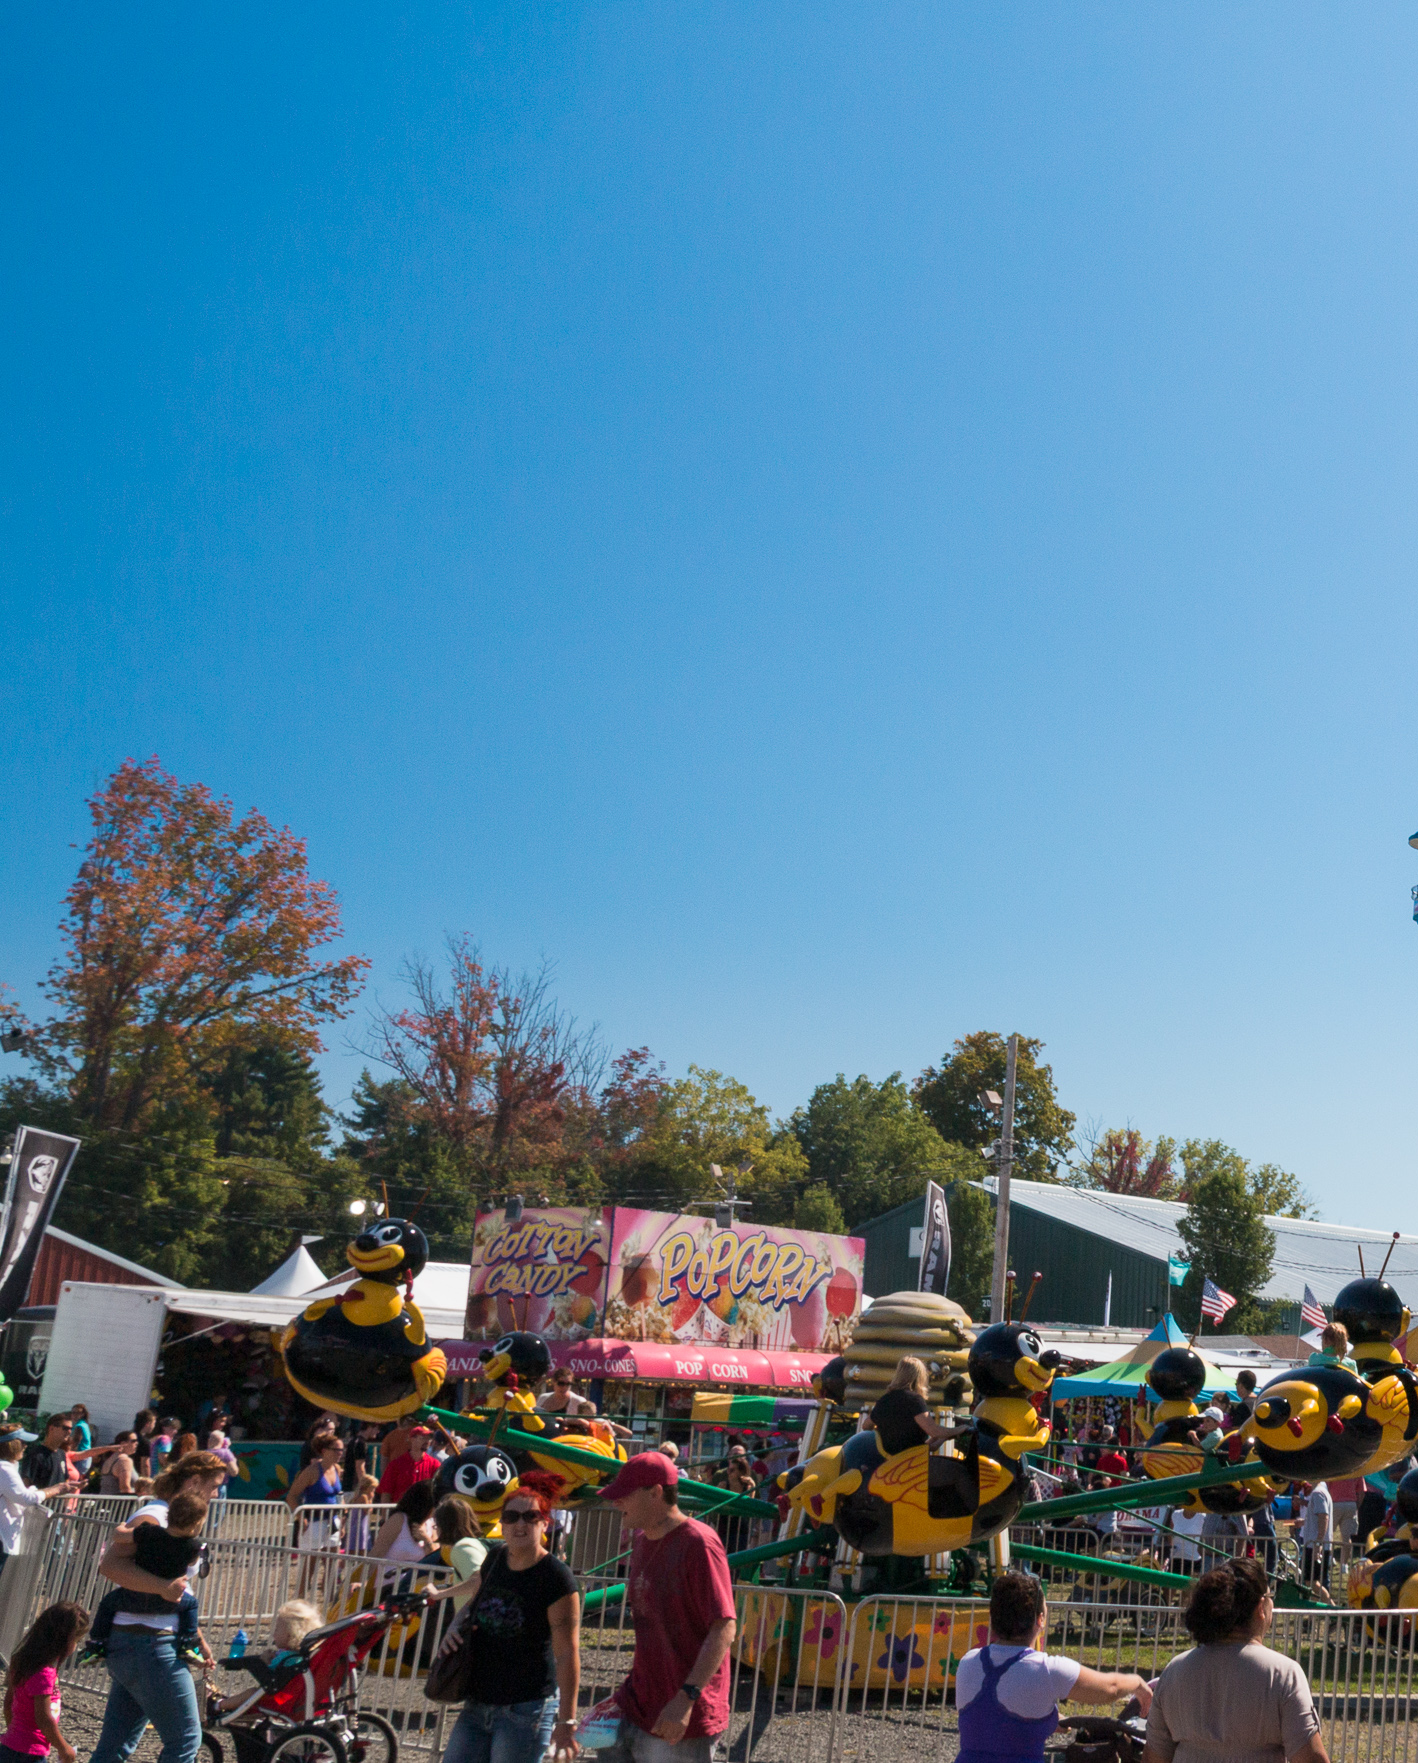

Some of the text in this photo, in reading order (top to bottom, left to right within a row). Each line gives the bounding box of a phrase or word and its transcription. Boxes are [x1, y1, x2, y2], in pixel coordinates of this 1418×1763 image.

[658, 1231, 833, 1312] POPCORN
[604, 1358, 635, 1373] CONES
[675, 1360, 703, 1375] POP
[712, 1363, 748, 1378] CORN
[18, 1385, 40, 1395] RA
